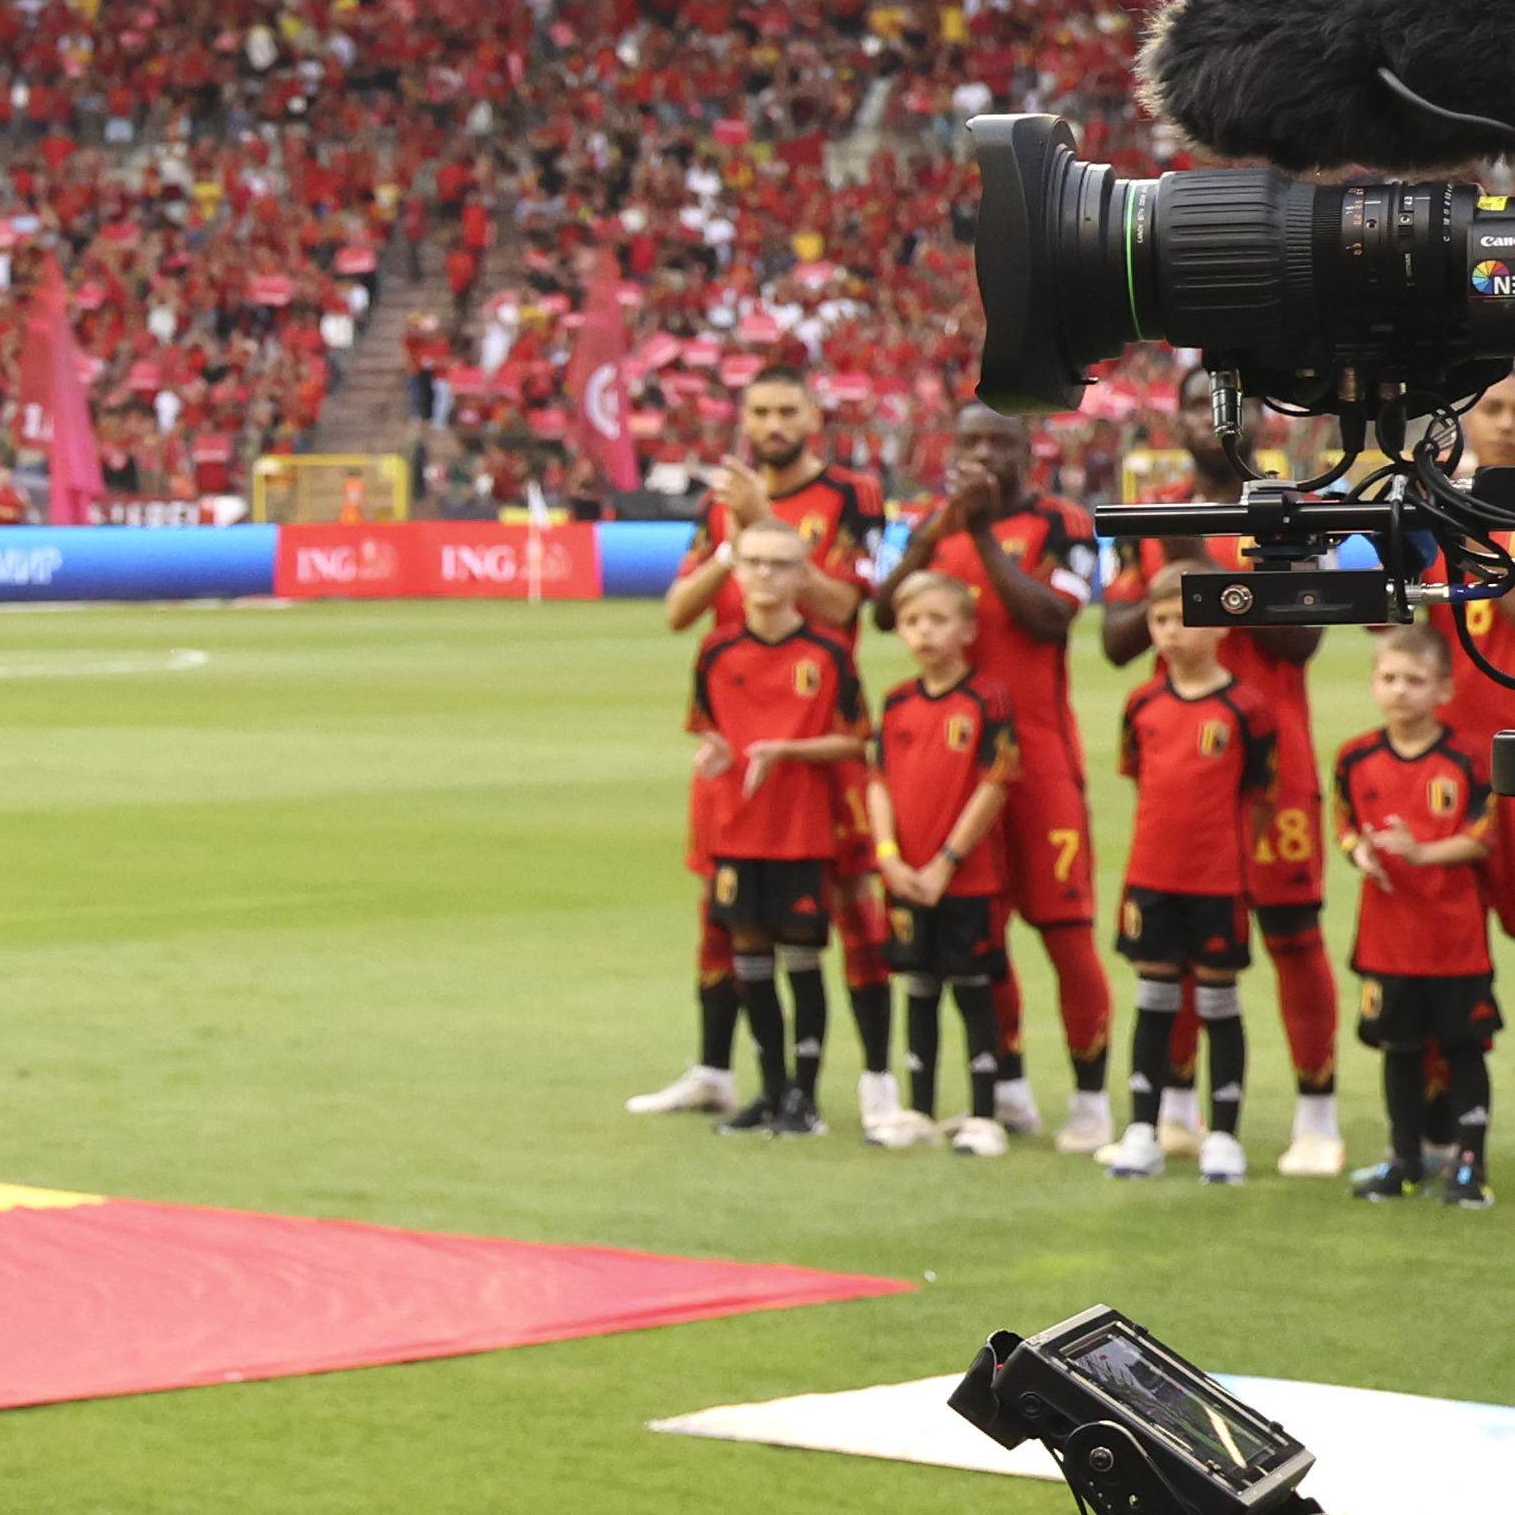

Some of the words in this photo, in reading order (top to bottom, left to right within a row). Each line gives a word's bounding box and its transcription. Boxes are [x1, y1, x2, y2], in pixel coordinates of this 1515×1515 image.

[1480, 235, 1515, 247] Can
[296, 545, 358, 583] ING
[441, 544, 517, 582] ING
[1048, 828, 1081, 882] 7
